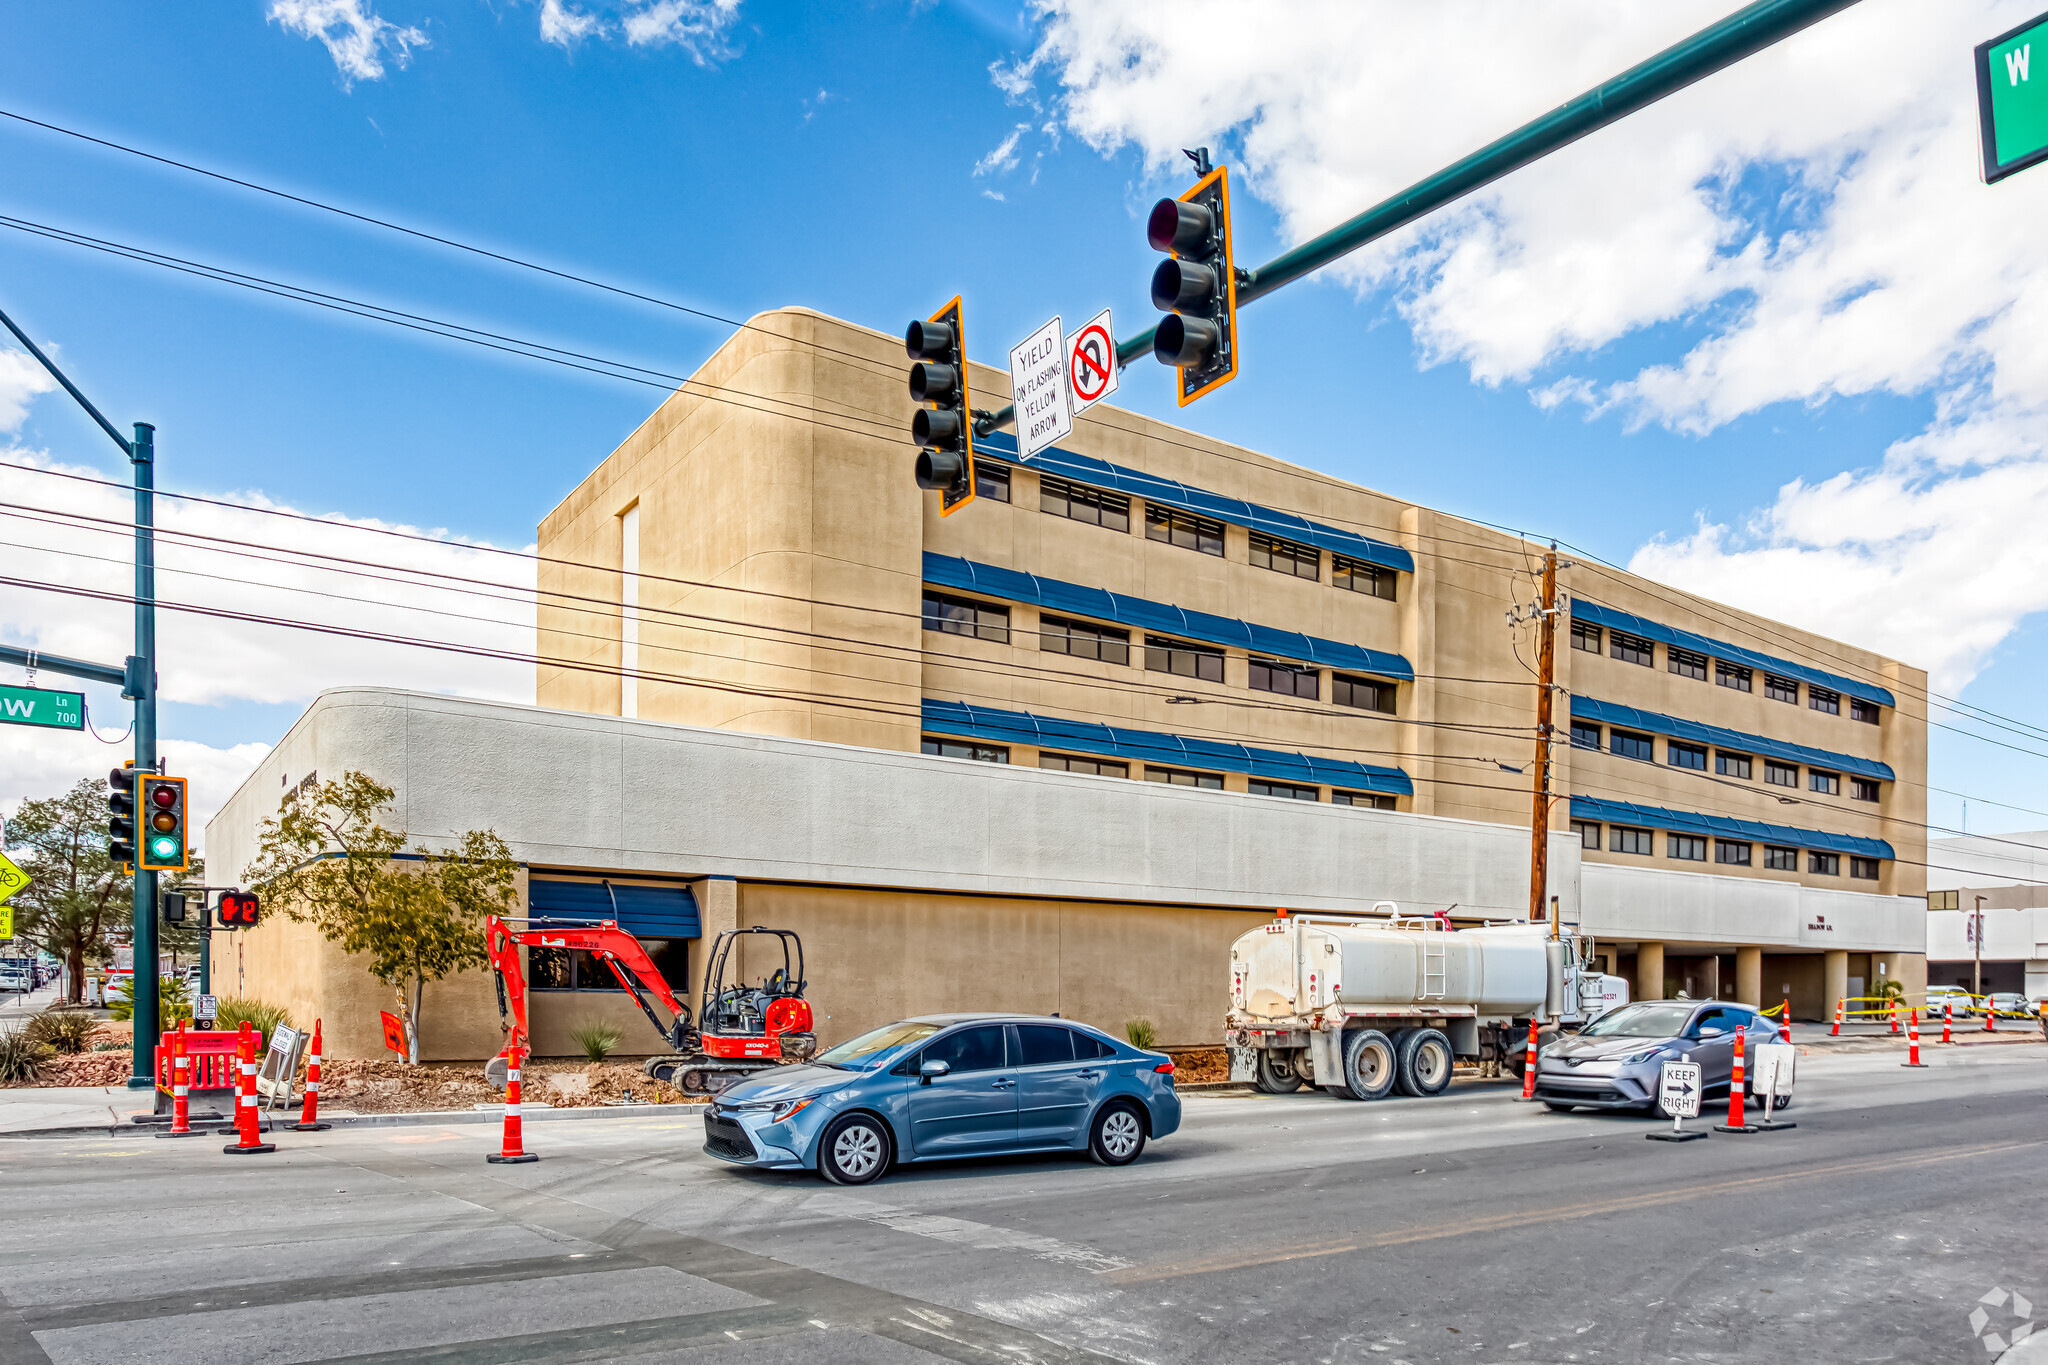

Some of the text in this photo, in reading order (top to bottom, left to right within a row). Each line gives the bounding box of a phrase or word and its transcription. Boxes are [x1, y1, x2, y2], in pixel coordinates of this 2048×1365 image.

[2005, 43, 2030, 87] W
[1019, 337, 1053, 372] YIELD
[1016, 361, 1061, 402] ON FLASHING
[1025, 388, 1056, 419] YELLOW
[1030, 412, 1057, 441] ARROW
[56, 695, 68, 707] Ln
[56, 711, 77, 724] 700
[1667, 1069, 1696, 1081] KEEP
[1662, 1097, 1697, 1110] RIGHT
